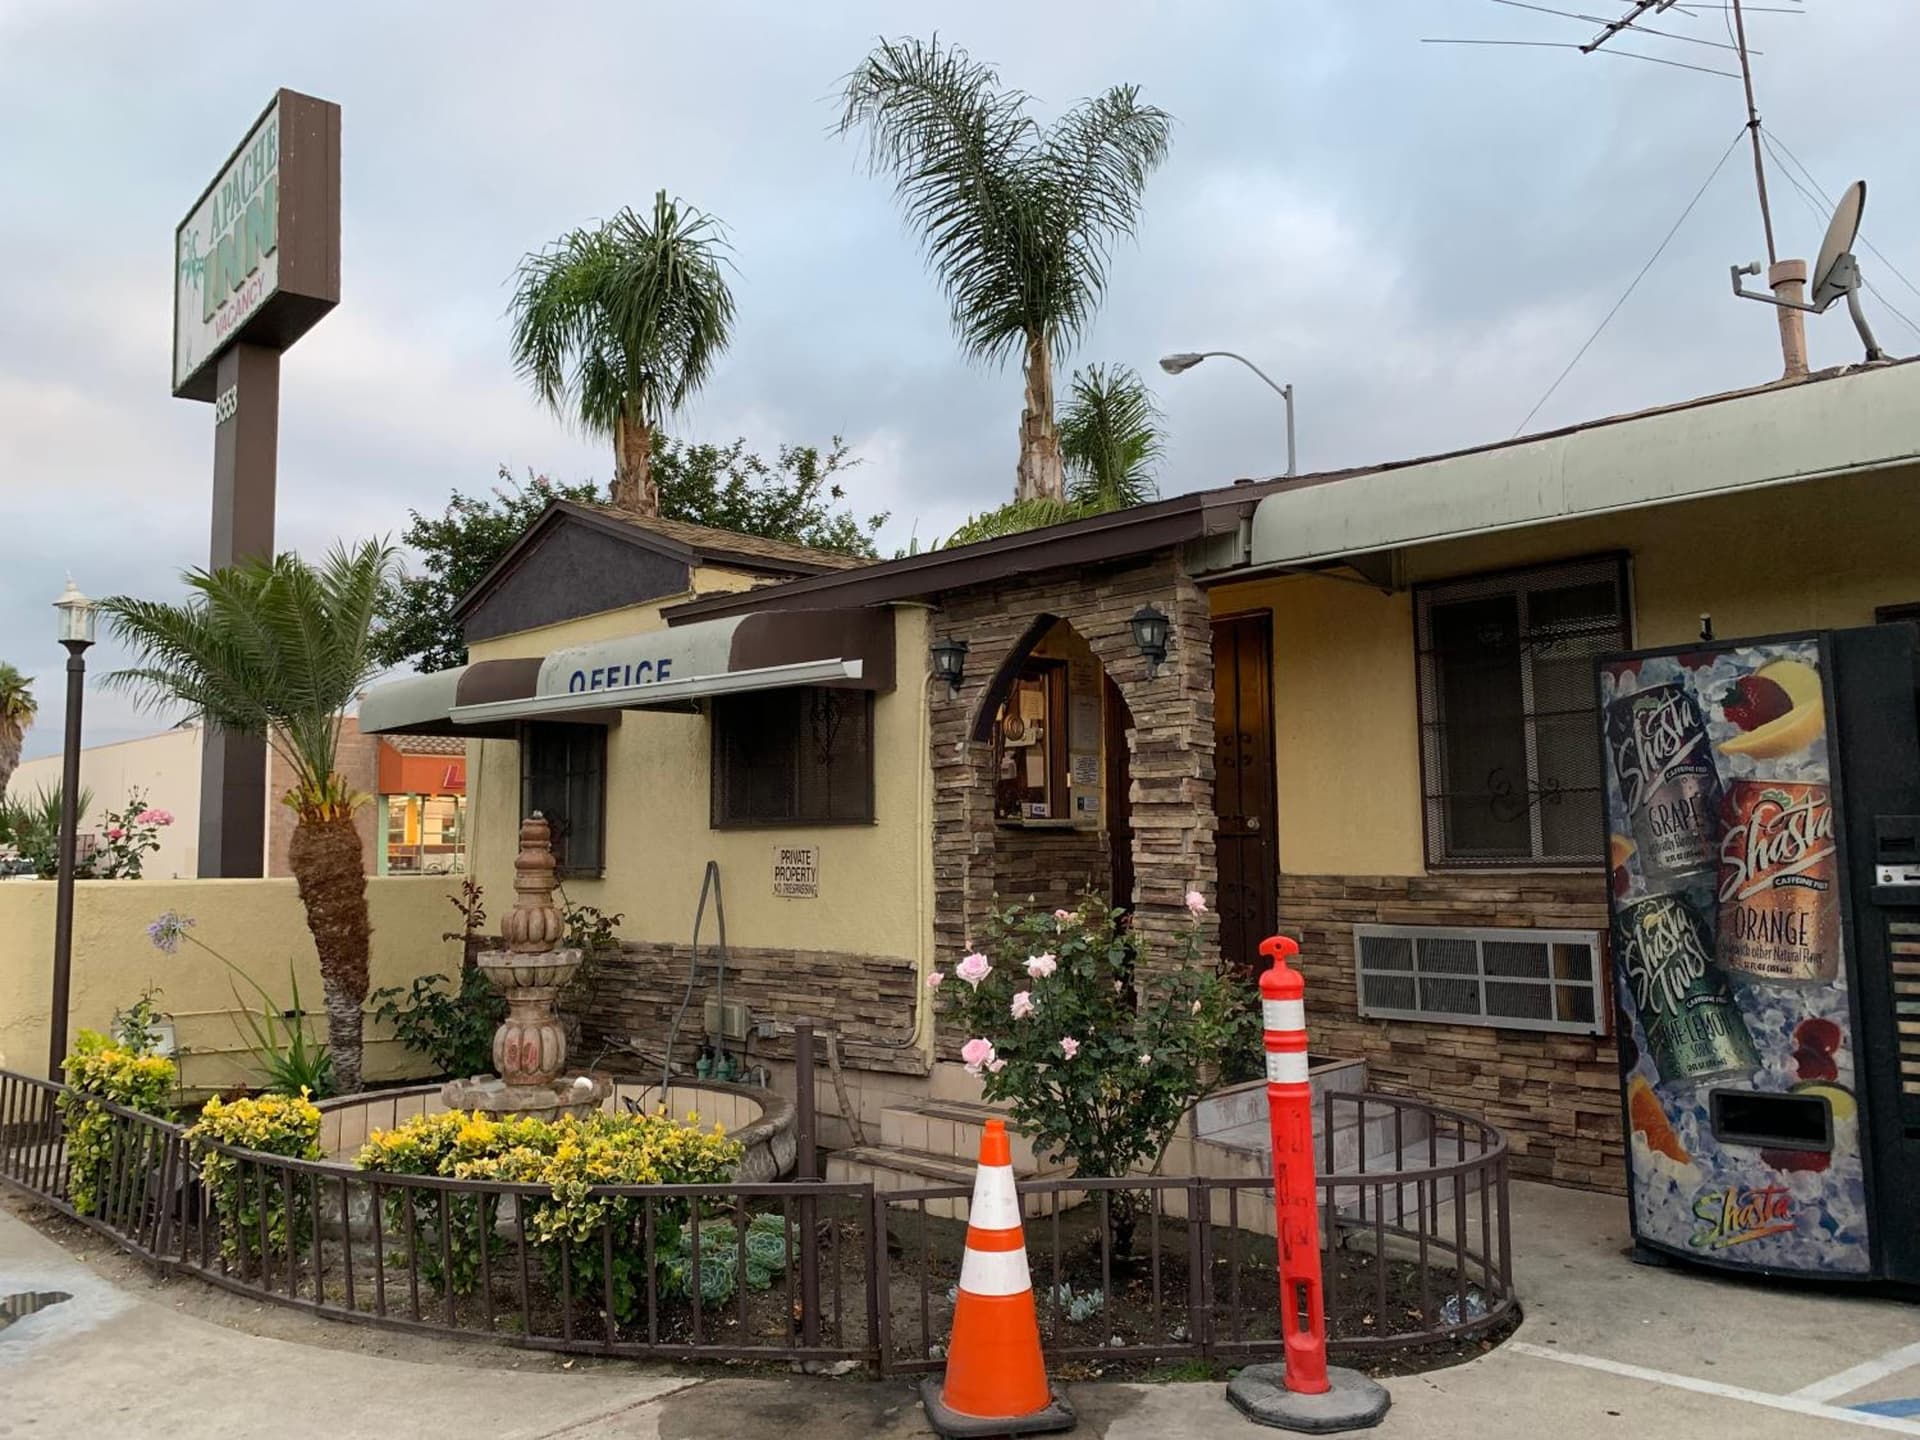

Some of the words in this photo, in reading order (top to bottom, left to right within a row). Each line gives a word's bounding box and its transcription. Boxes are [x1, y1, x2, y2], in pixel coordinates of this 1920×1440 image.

[209, 119, 277, 246] APACHE
[203, 174, 278, 324] INN
[216, 272, 265, 339] VACANCY
[569, 659, 673, 693] OFFICE
[1618, 687, 1702, 816] Shasta
[1649, 792, 1704, 837] GRAPE
[1719, 787, 1835, 902] Shasta
[775, 866, 816, 882] PROPERTY
[780, 850, 811, 865] PRIVATE
[1620, 899, 1694, 1011] Shasta
[1734, 905, 1809, 946] ORANGE
[1689, 1186, 1797, 1247] Shasta
